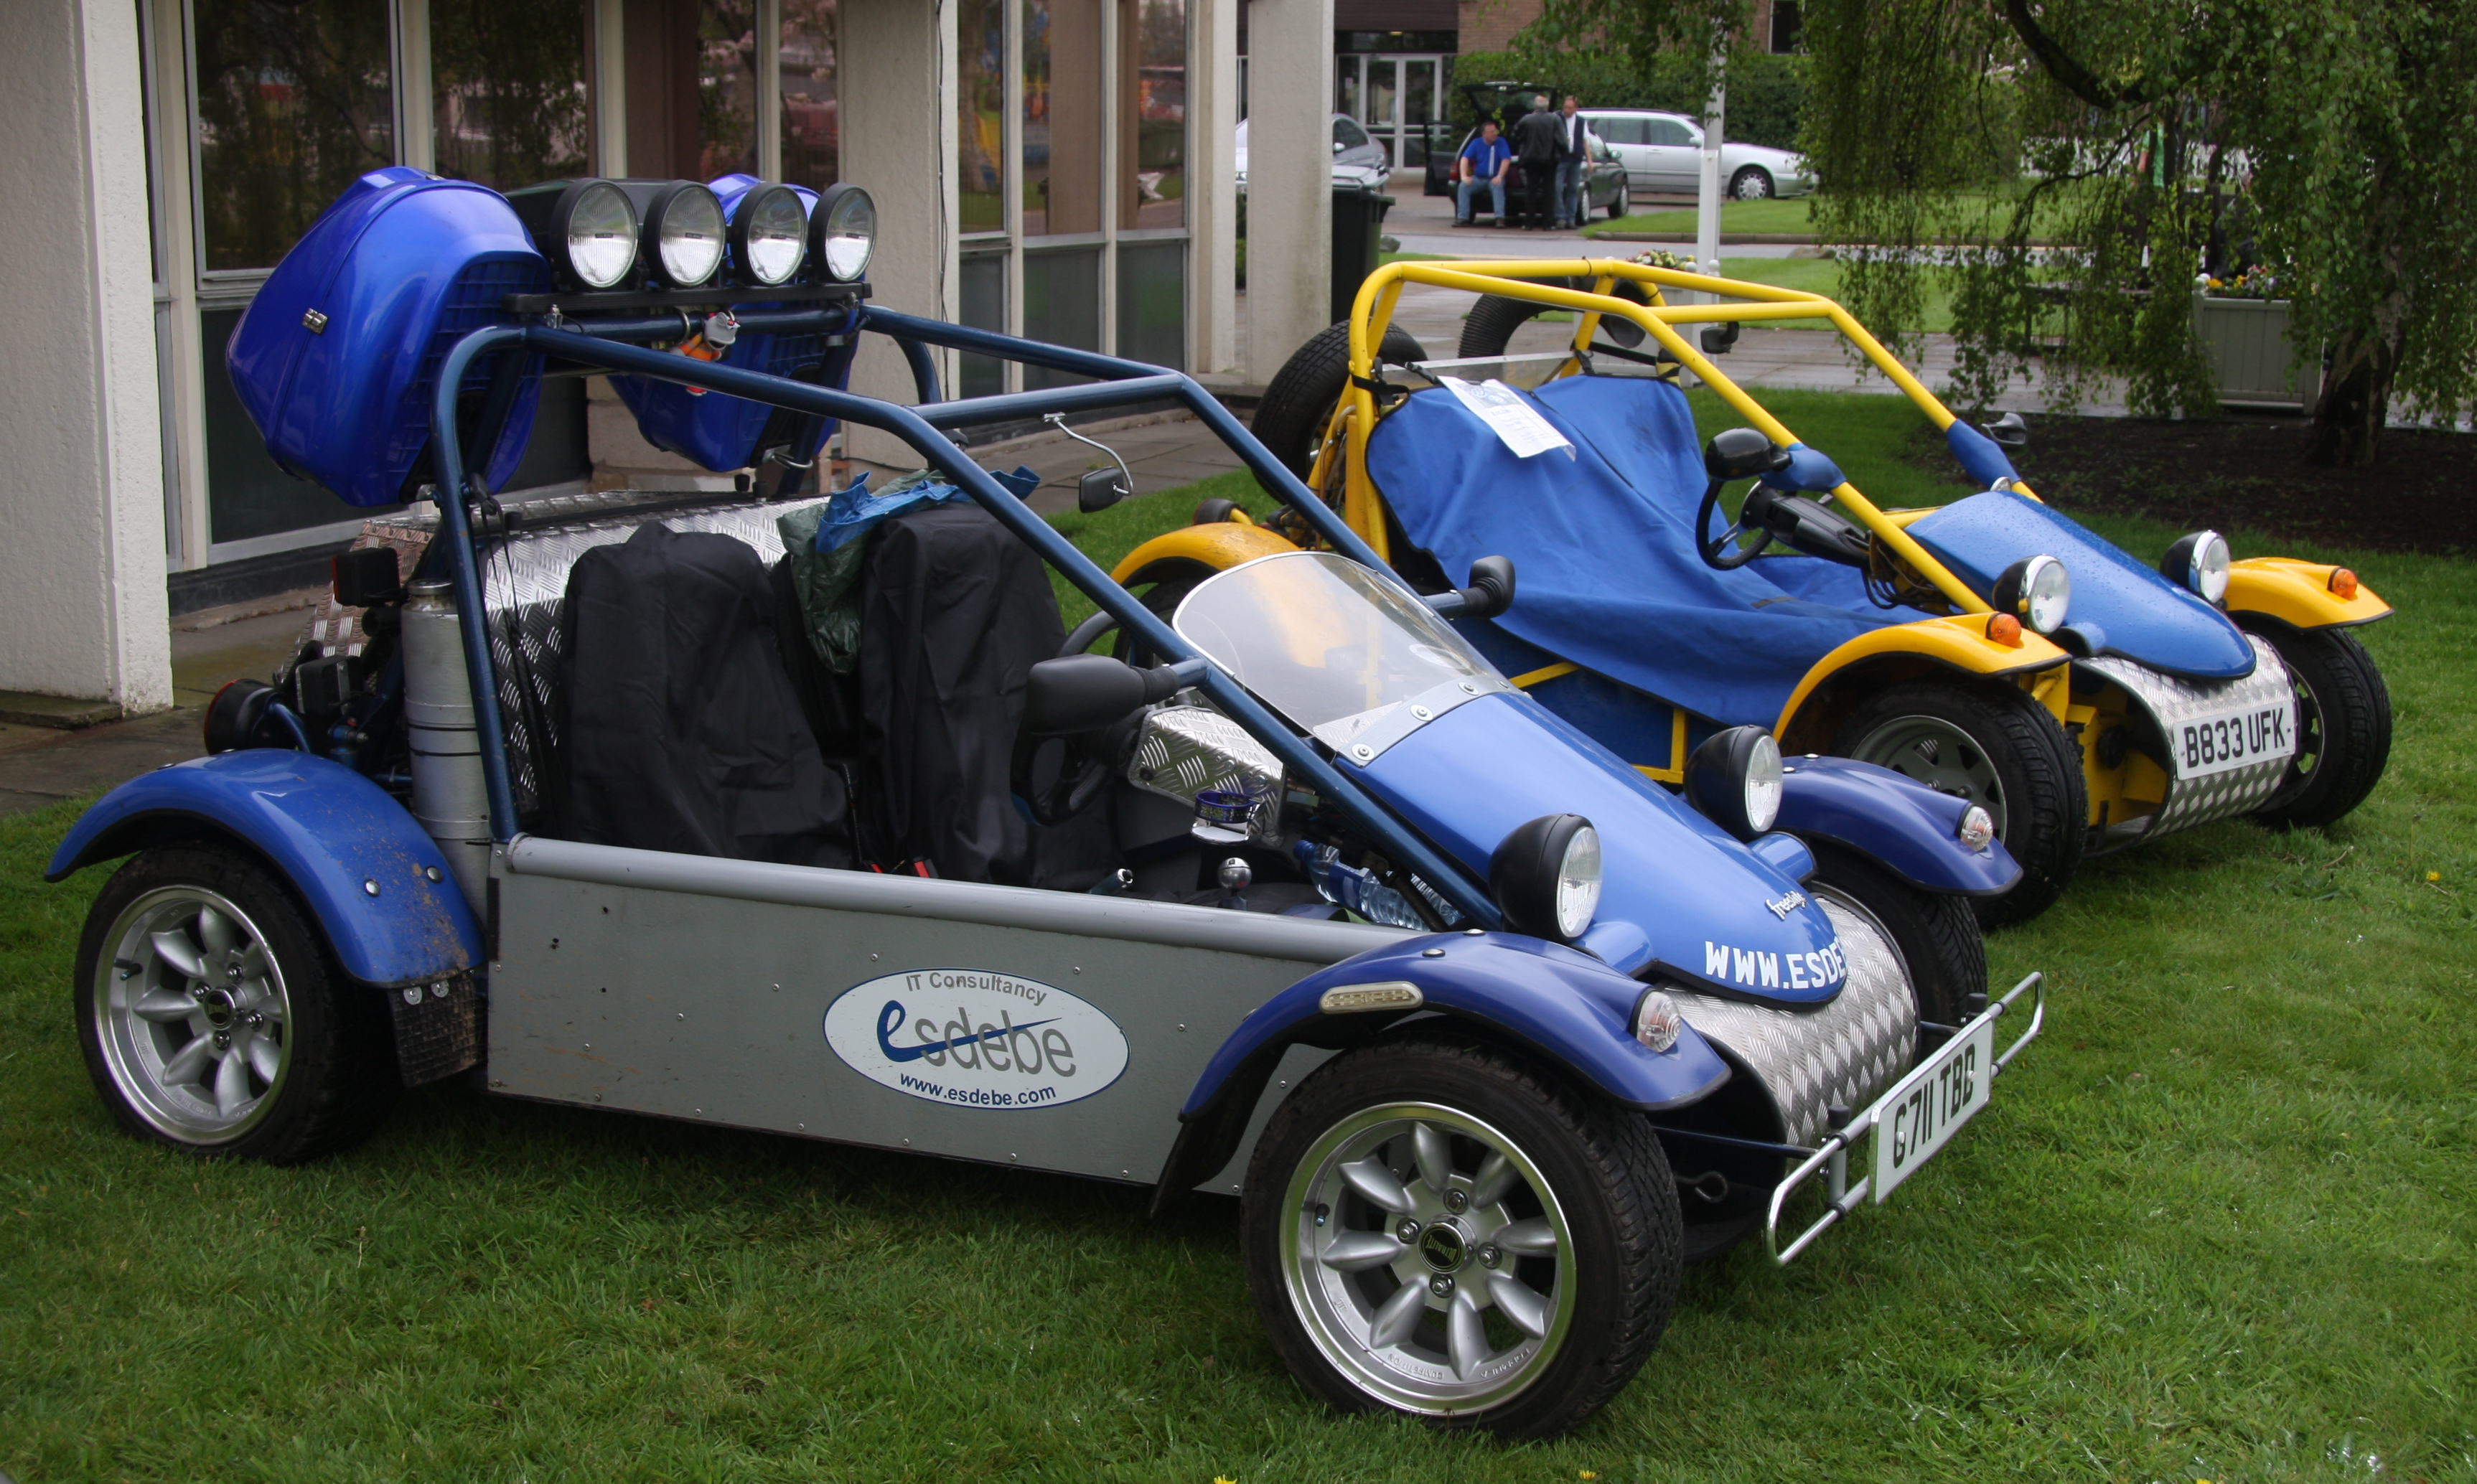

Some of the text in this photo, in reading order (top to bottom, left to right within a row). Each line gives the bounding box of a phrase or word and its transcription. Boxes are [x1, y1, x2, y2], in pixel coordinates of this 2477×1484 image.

[2183, 708, 2285, 769] B833 UFK
[906, 972, 1047, 1006] IT Consultancy
[876, 1000, 1076, 1077] esdebe
[899, 1073, 1057, 1106] www.esdebe.com
[1893, 1078, 1934, 1169] G711
